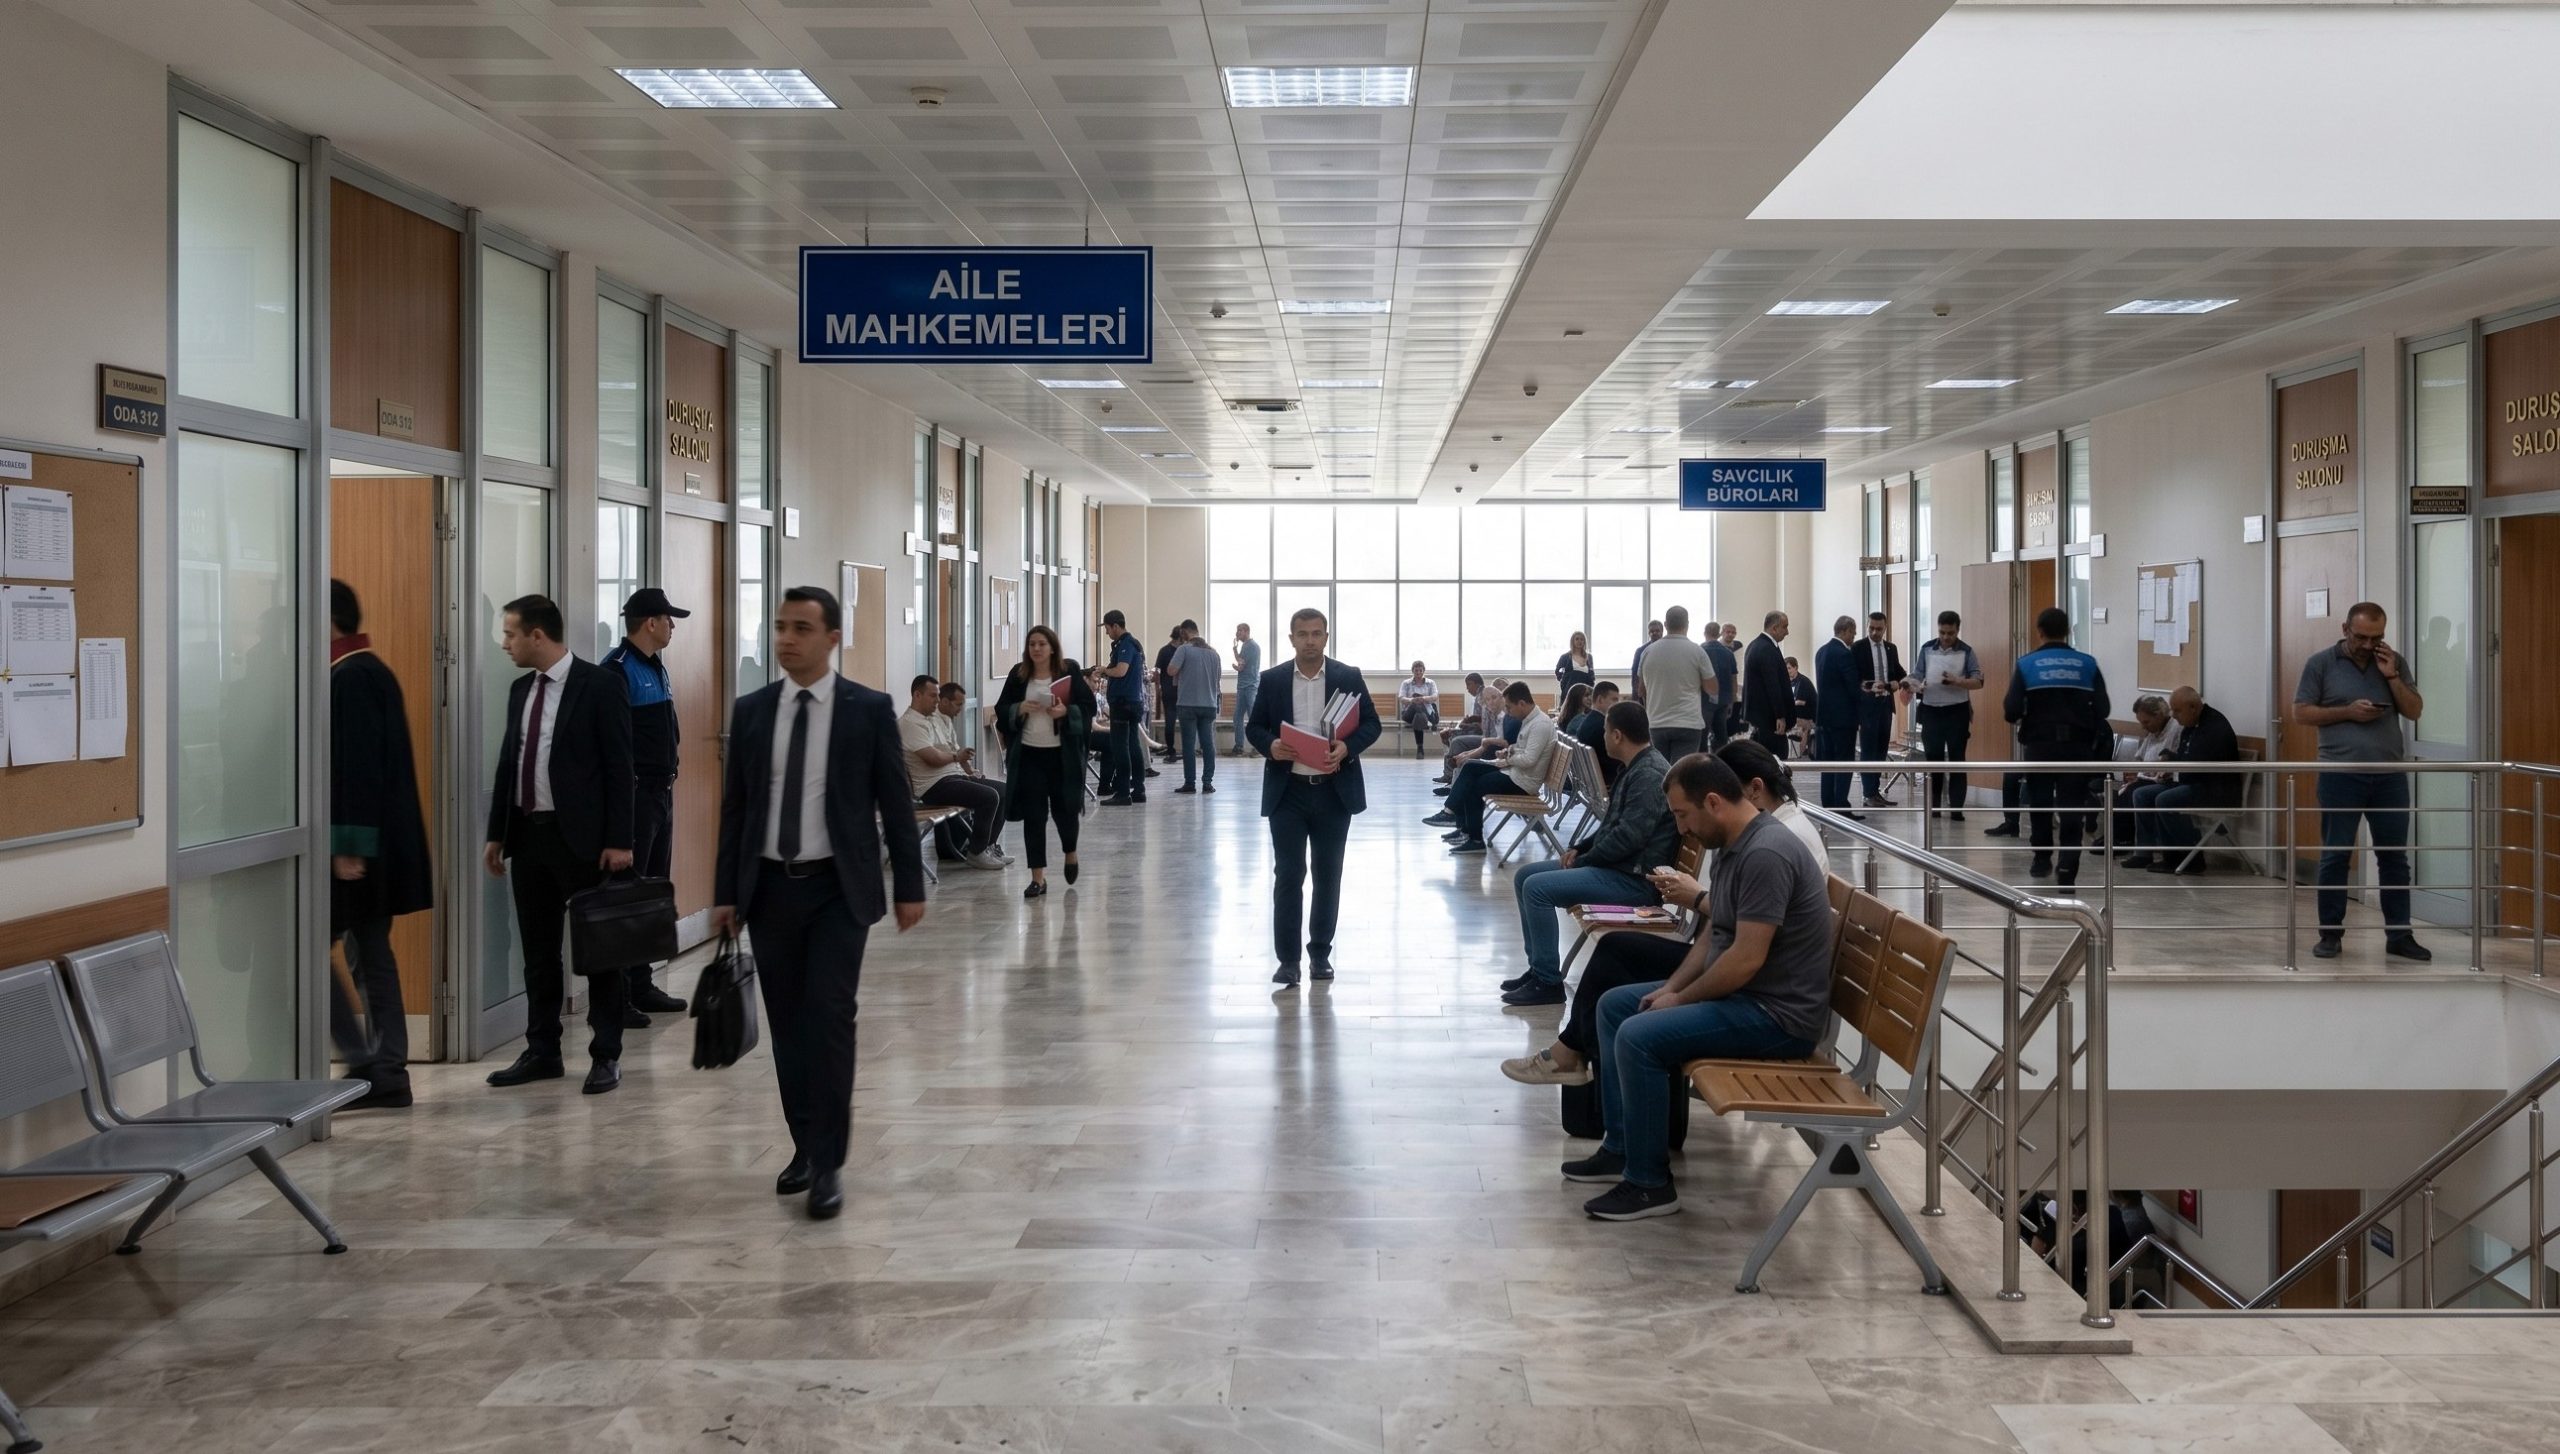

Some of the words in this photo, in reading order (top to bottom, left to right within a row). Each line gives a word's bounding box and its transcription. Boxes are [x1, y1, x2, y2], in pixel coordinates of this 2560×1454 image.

[929, 262, 1021, 300] AİLE
[825, 306, 1127, 345] MAHKEMELERİ
[113, 404, 138, 424] ODA
[140, 409, 159, 427] 312
[667, 399, 715, 433] DURUŞMA
[2506, 391, 2560, 423] DURUŞ
[671, 433, 711, 463] SALONU
[2291, 434, 2348, 462] DURUŞMA
[2512, 427, 2560, 457] SALO
[1711, 468, 1794, 483] SAVCILIK
[2296, 464, 2342, 490] SALONU
[1706, 484, 1799, 503] BÜROLARI
